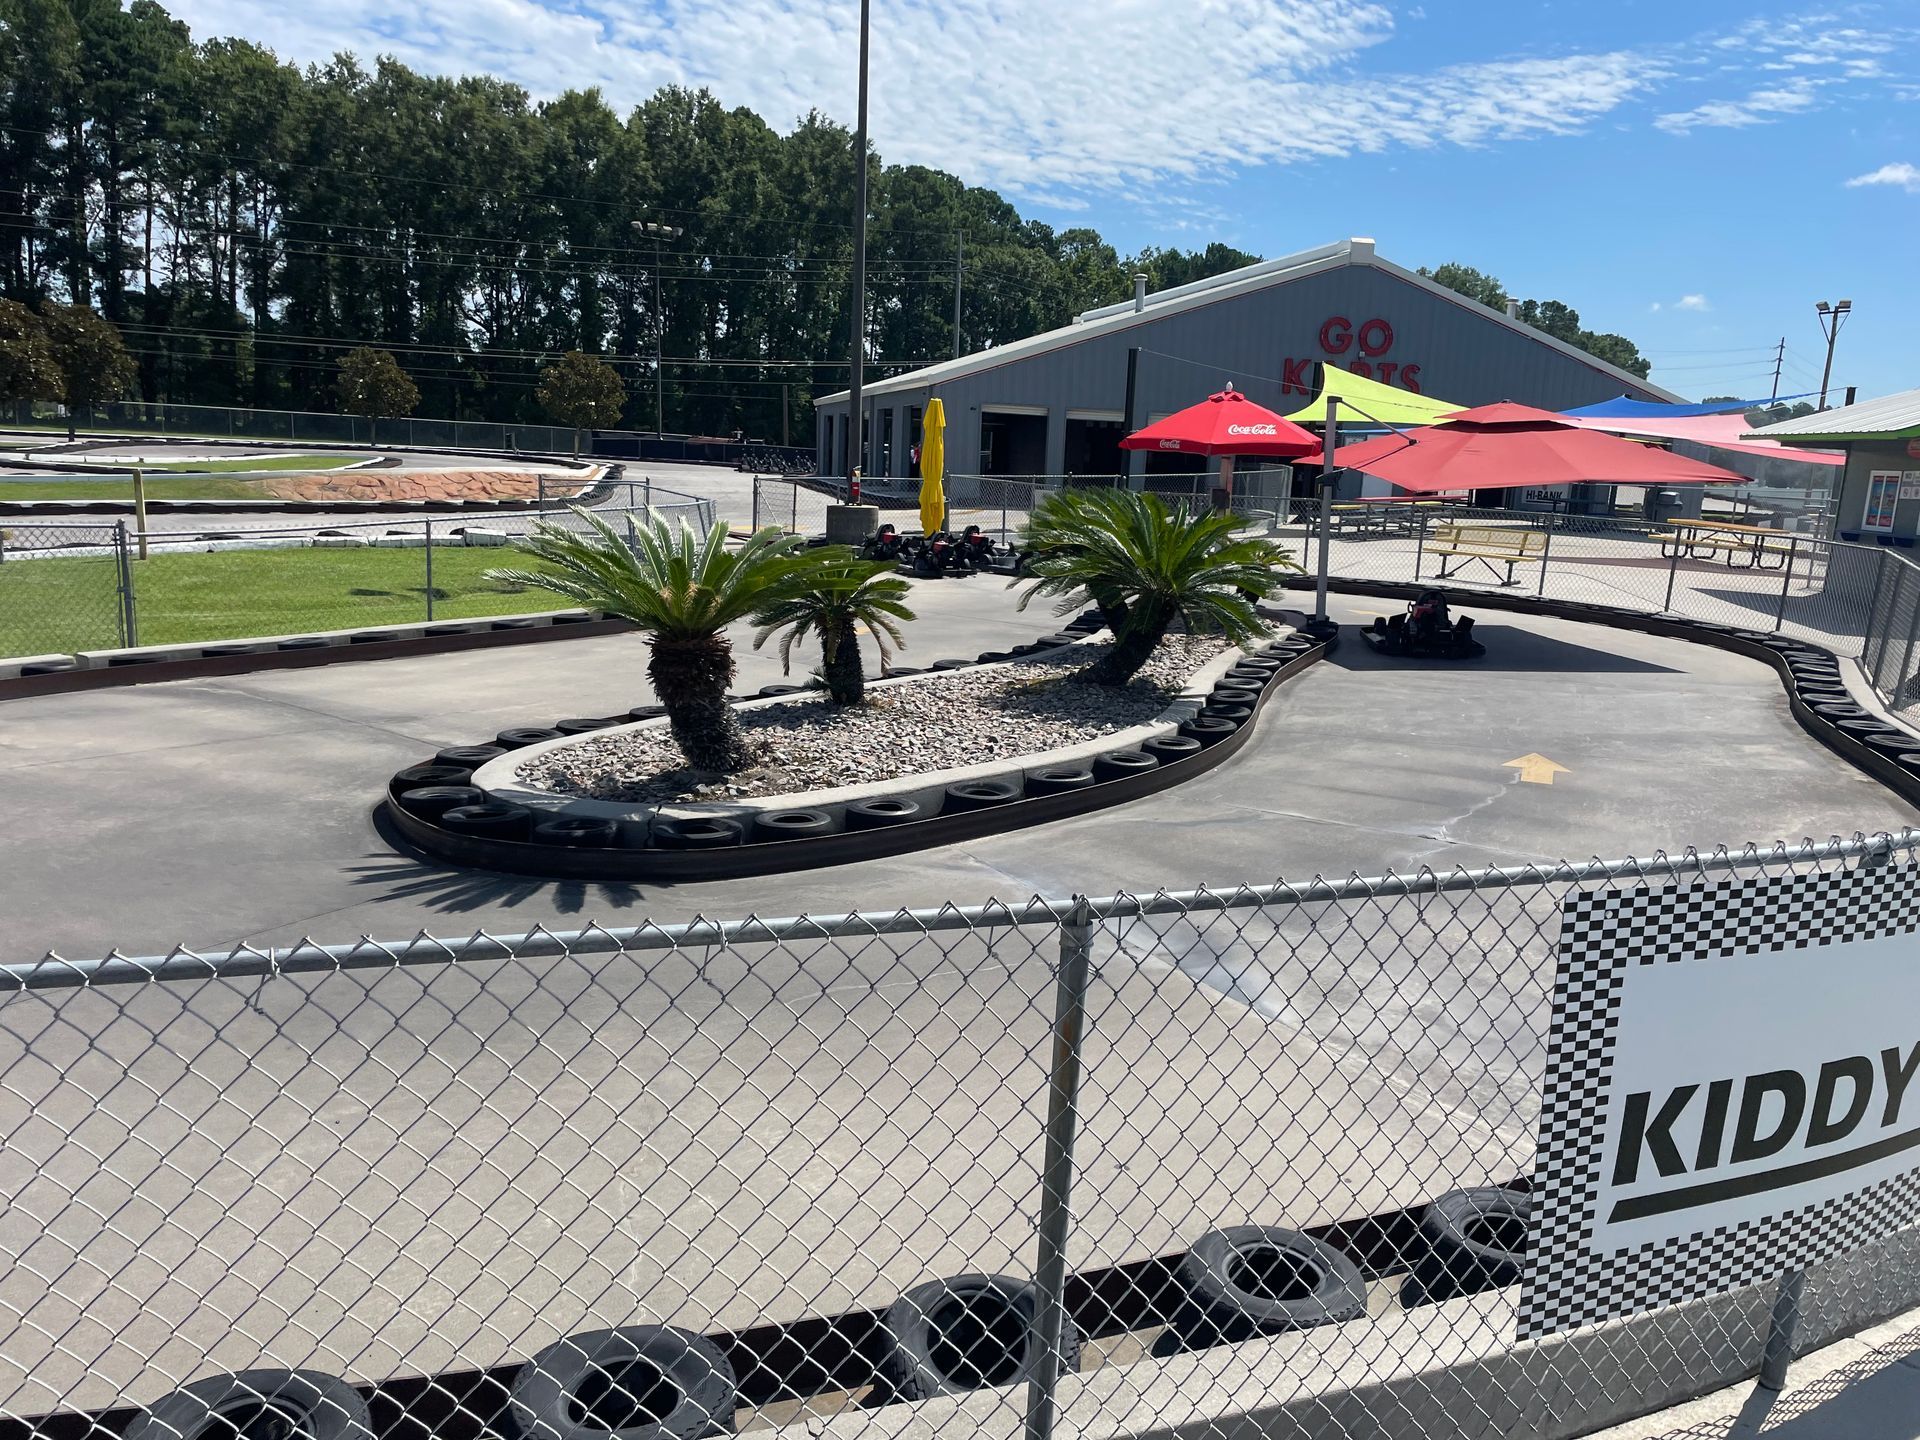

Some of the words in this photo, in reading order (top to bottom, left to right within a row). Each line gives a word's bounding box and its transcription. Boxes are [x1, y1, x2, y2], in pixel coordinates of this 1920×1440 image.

[1320, 316, 1393, 357] GO
[1282, 358, 1421, 395] KTS
[1228, 424, 1277, 436] Coca-Cola
[1526, 490, 1563, 500] HI-BANK
[1611, 1040, 1920, 1187] KIDDY
